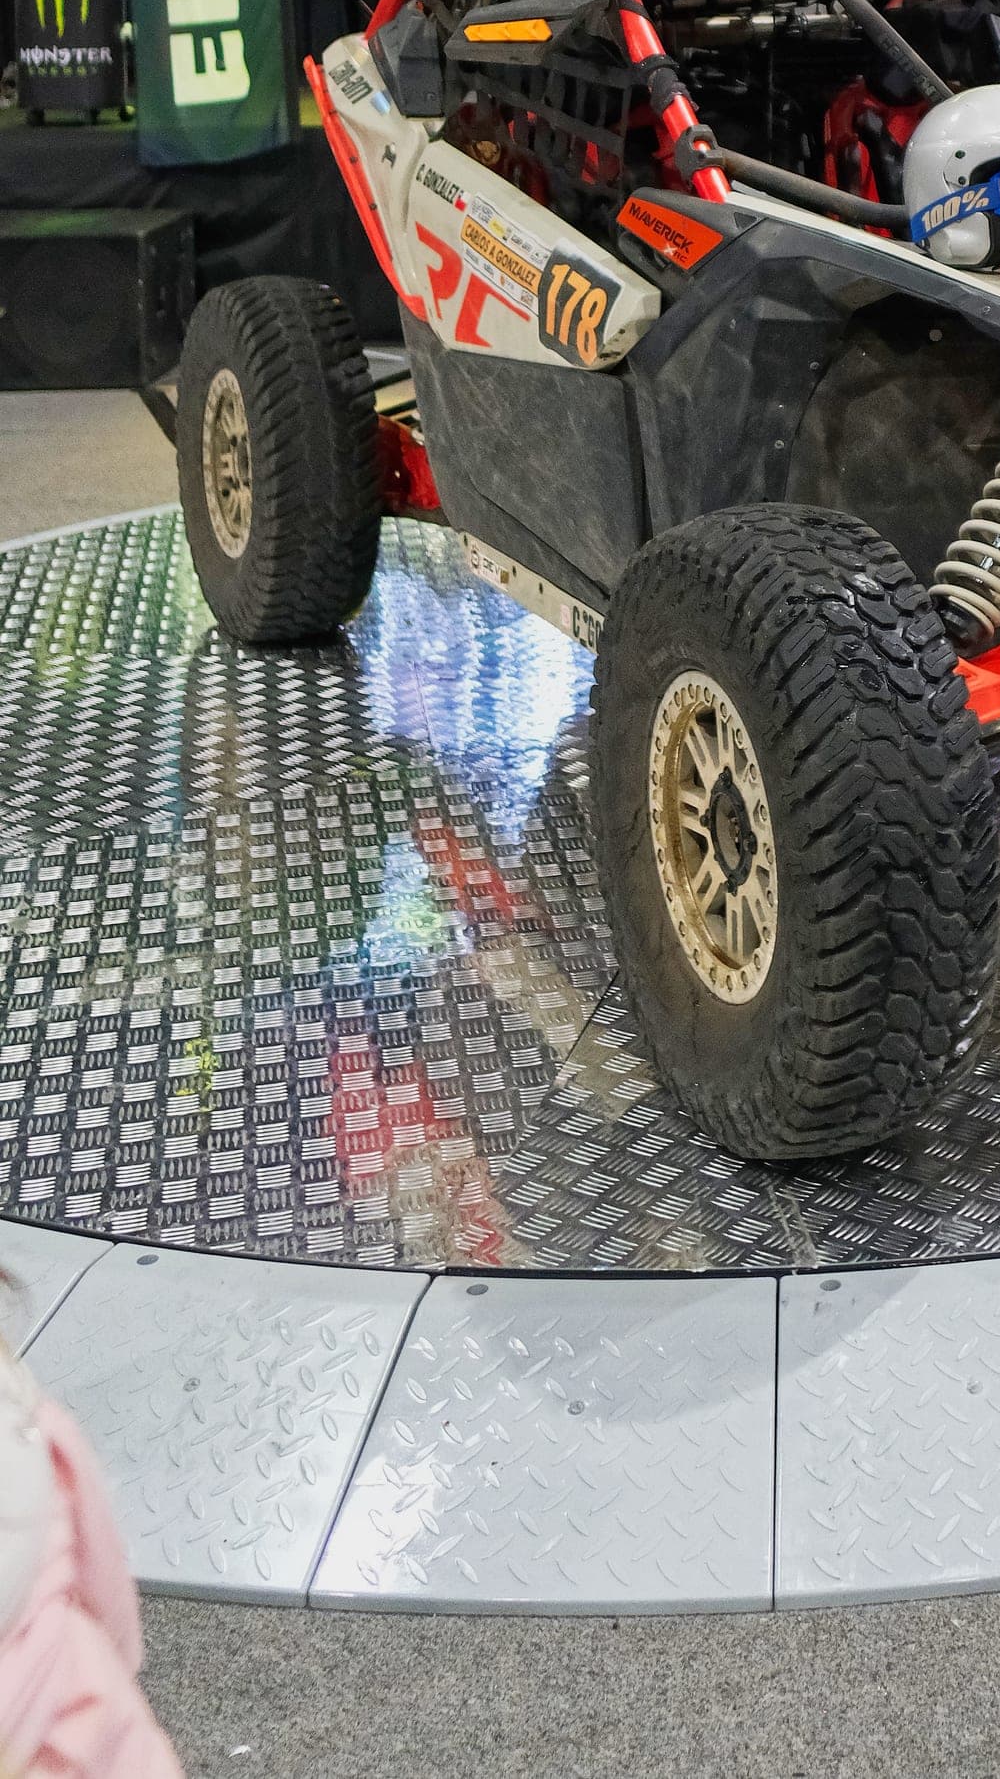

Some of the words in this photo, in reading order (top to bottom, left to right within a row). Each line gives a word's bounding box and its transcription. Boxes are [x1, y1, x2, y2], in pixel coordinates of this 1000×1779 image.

[20, 45, 113, 67] MONSTER
[423, 167, 460, 204] GONZALEZ
[922, 187, 988, 232] 100%
[629, 202, 694, 254] MAVERICK
[465, 224, 489, 251] CARLOS
[496, 250, 536, 287] GONZALEZ
[546, 262, 609, 366] 178
